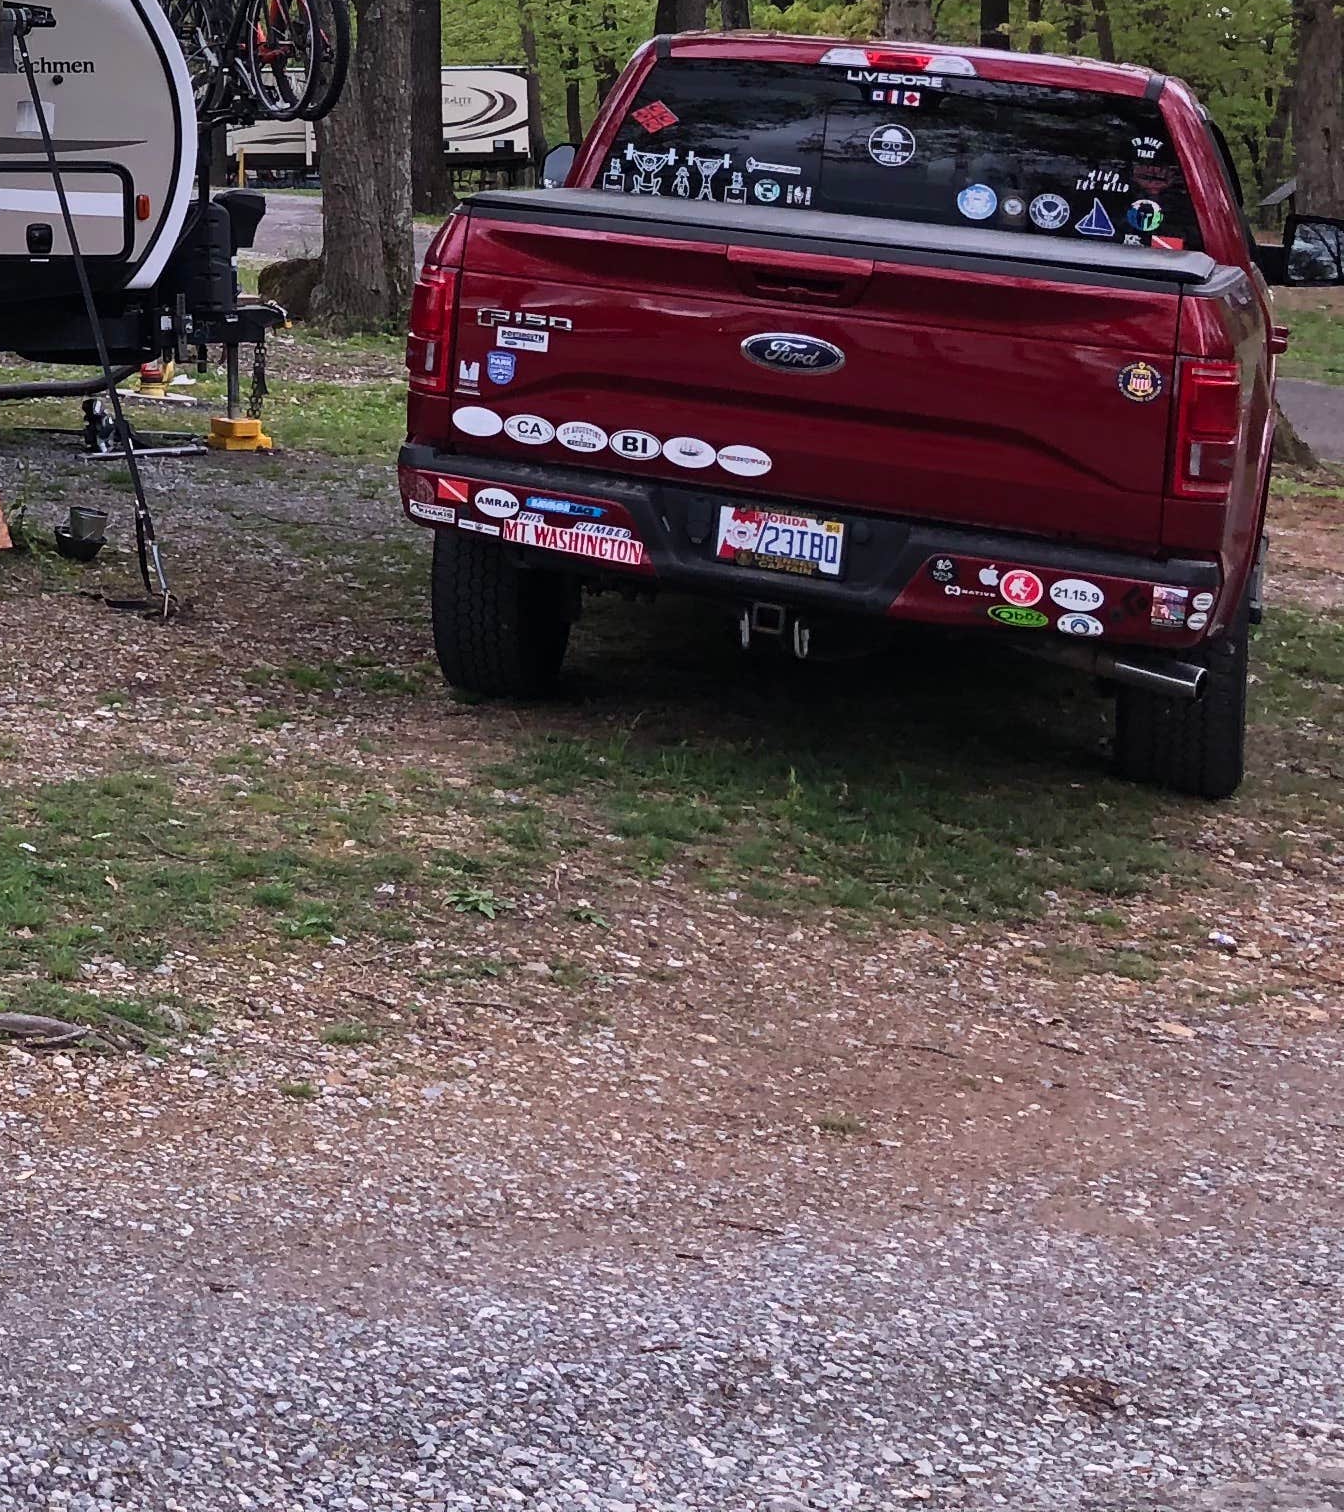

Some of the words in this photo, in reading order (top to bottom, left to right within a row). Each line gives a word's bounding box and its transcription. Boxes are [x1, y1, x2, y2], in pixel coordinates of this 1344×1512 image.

[17, 56, 96, 74] achmen
[846, 70, 945, 88] LIVESORE
[1136, 149, 1157, 159] THAT
[764, 339, 821, 366] Ford
[489, 357, 513, 368] PARK
[517, 420, 543, 437] CA
[621, 434, 649, 454] BI
[476, 495, 519, 510] AMRAP
[519, 511, 546, 524] THIS
[575, 522, 632, 539] CLIMBED
[755, 511, 810, 528] FLORIDA
[534, 523, 643, 564] WASHINGTON
[1053, 586, 1101, 604] 21.15.9
